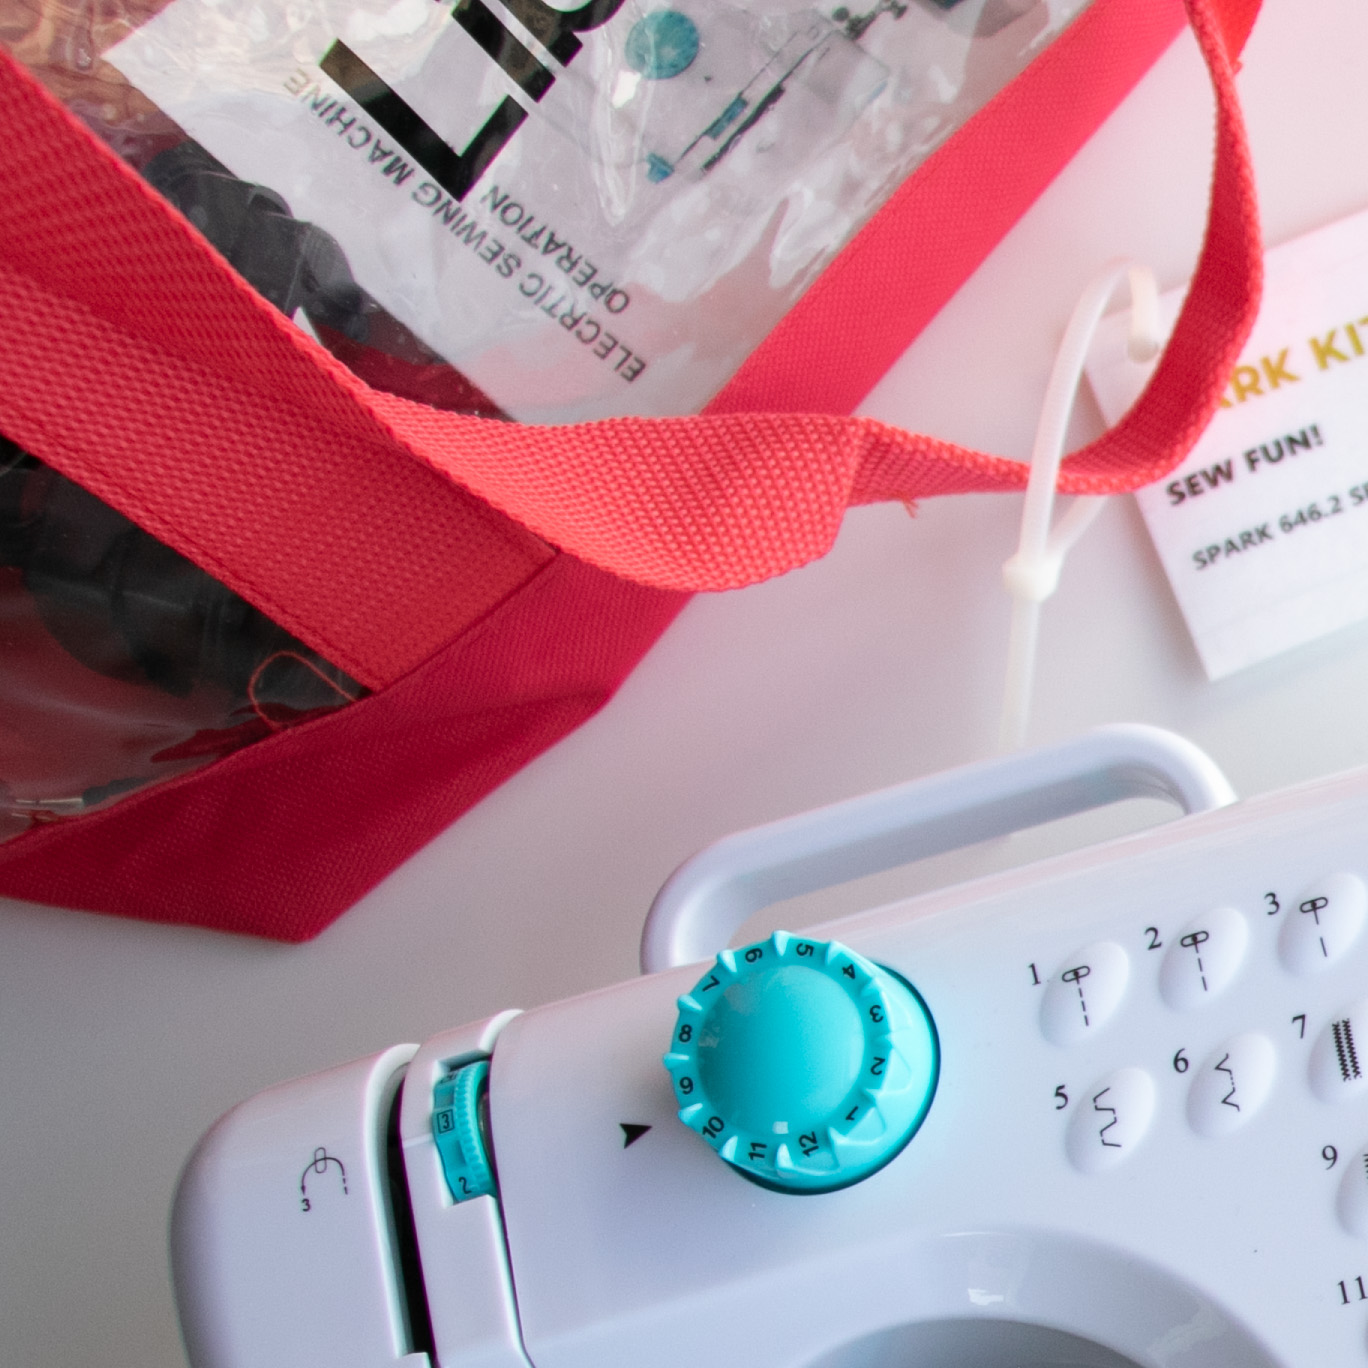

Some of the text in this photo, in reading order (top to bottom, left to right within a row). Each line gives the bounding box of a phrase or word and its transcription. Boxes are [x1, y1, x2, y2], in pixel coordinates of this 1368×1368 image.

[279, 64, 418, 190] MACHINE
[407, 175, 526, 283] SEWING
[477, 178, 633, 319] OPERATION
[1164, 423, 1324, 507] SEW FUN!
[1191, 522, 1275, 571] SPARK
[1277, 493, 1344, 535] 646.2
[1265, 892, 1280, 916] 3
[1145, 926, 1162, 950] 2
[744, 947, 763, 963] 6
[796, 943, 815, 957] 5
[842, 963, 856, 979] 4
[1029, 963, 1041, 985] 1
[702, 975, 721, 992] 7
[869, 1004, 884, 1023] 3
[678, 1024, 693, 1043] 8
[1292, 1013, 1306, 1039] 7
[870, 1056, 886, 1076] 2
[1173, 1048, 1189, 1074] 6
[679, 1076, 694, 1095] 9
[1054, 1084, 1069, 1110] 5
[702, 1116, 725, 1139] 10
[748, 1142, 767, 1161] 11
[798, 1131, 819, 1157] 12
[1321, 1145, 1338, 1169] 9
[458, 1176, 472, 1195] 2
[301, 1198, 311, 1212] 3
[1338, 1275, 1368, 1305] 11
